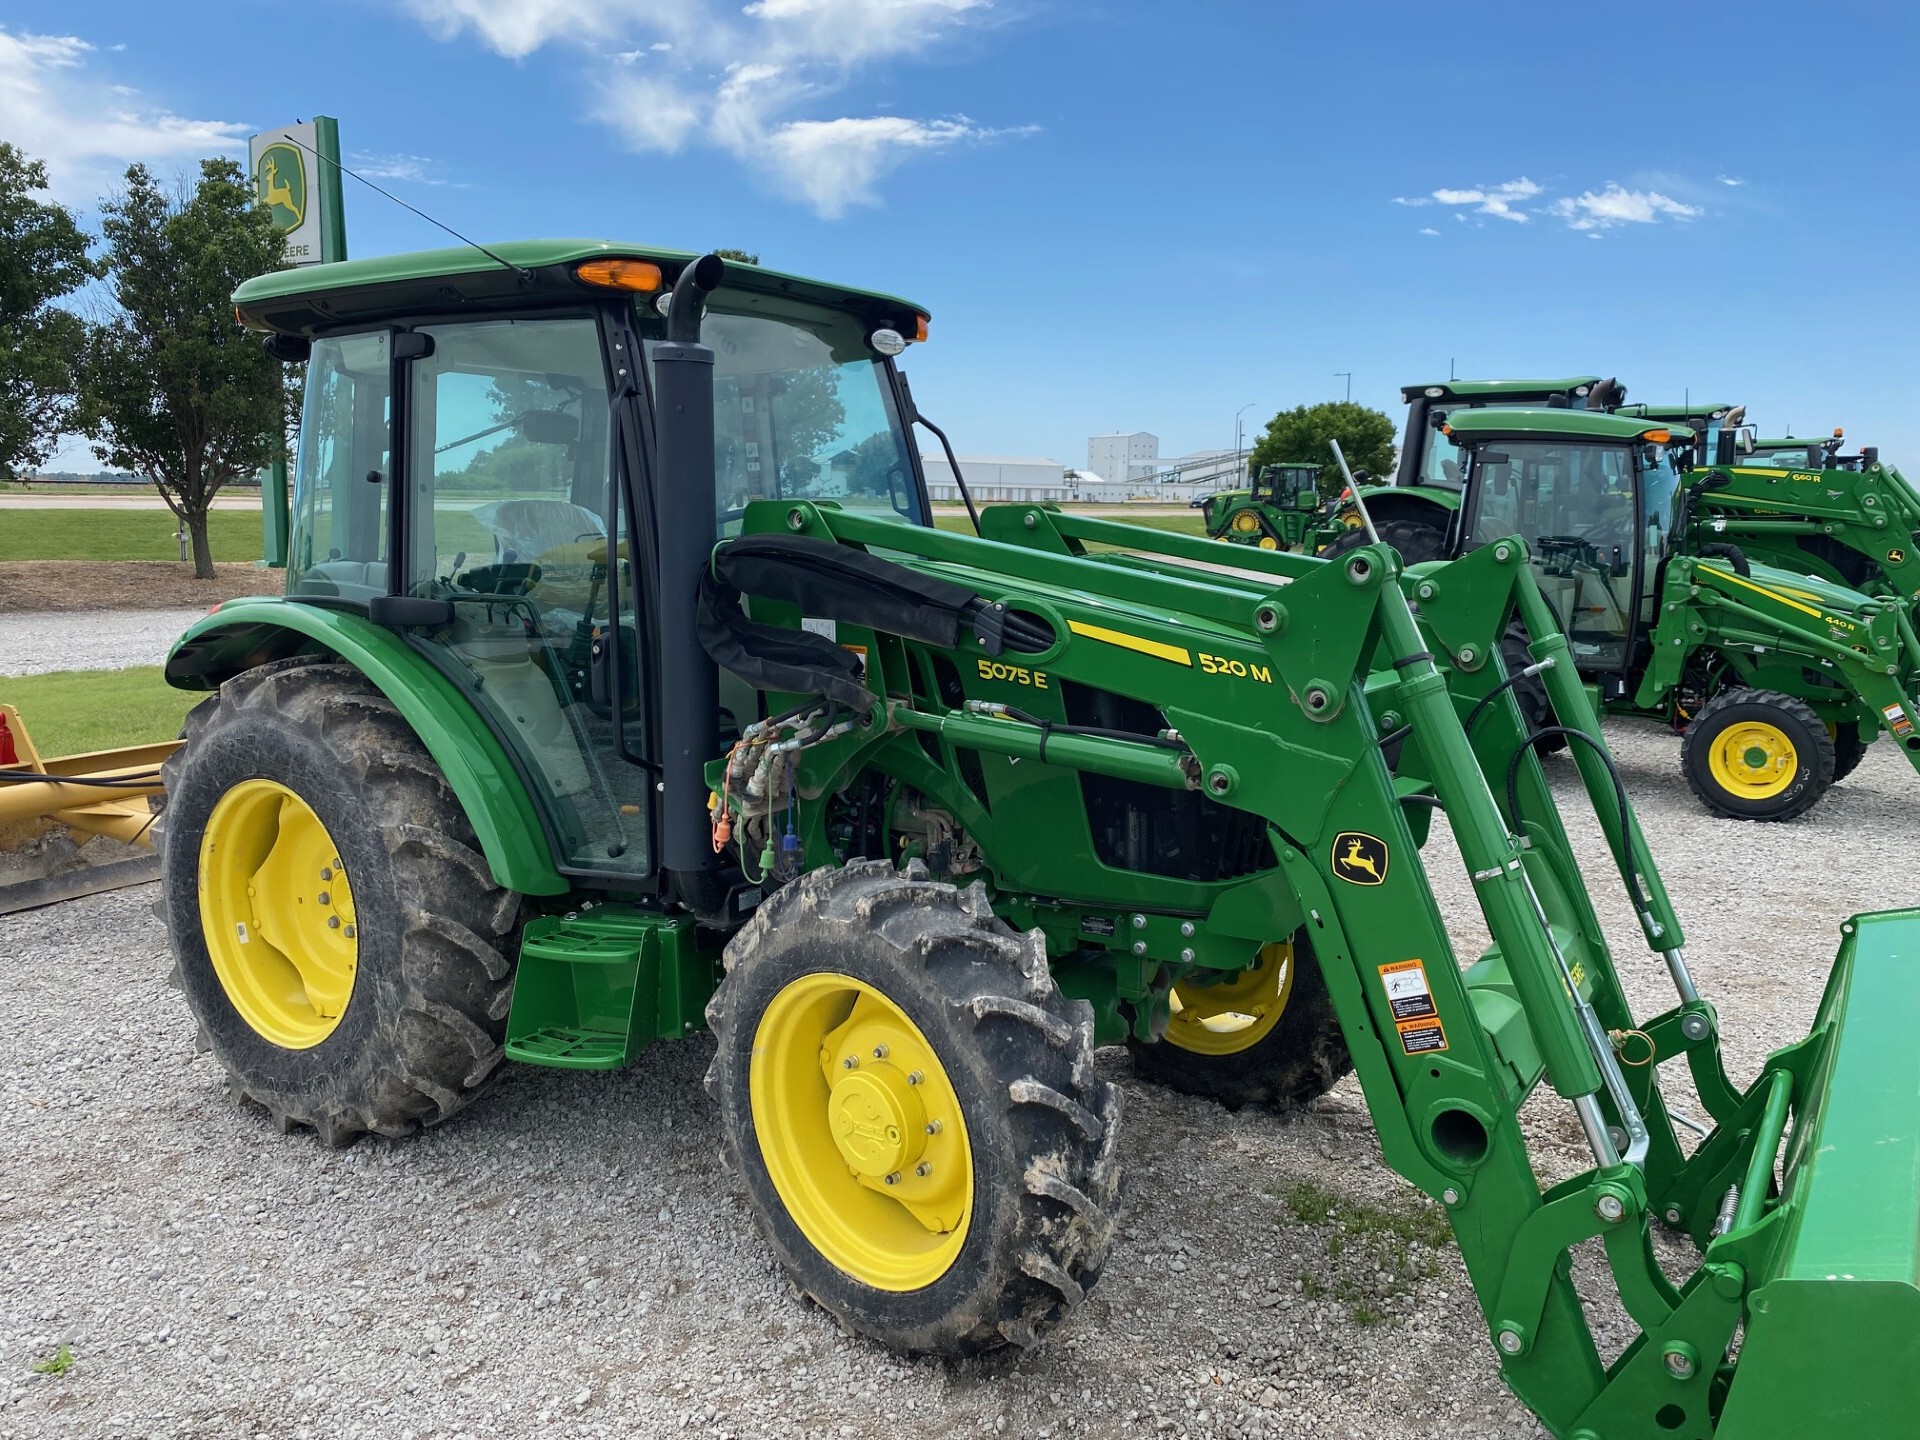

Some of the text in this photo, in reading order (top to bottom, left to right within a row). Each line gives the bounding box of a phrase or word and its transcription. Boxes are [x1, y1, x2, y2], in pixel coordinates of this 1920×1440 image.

[284, 245, 310, 258] EERE
[1813, 475, 1821, 483] R
[1825, 616, 1847, 628] 440
[977, 658, 1049, 690] 5075 E
[1197, 652, 1273, 684] 520 M
